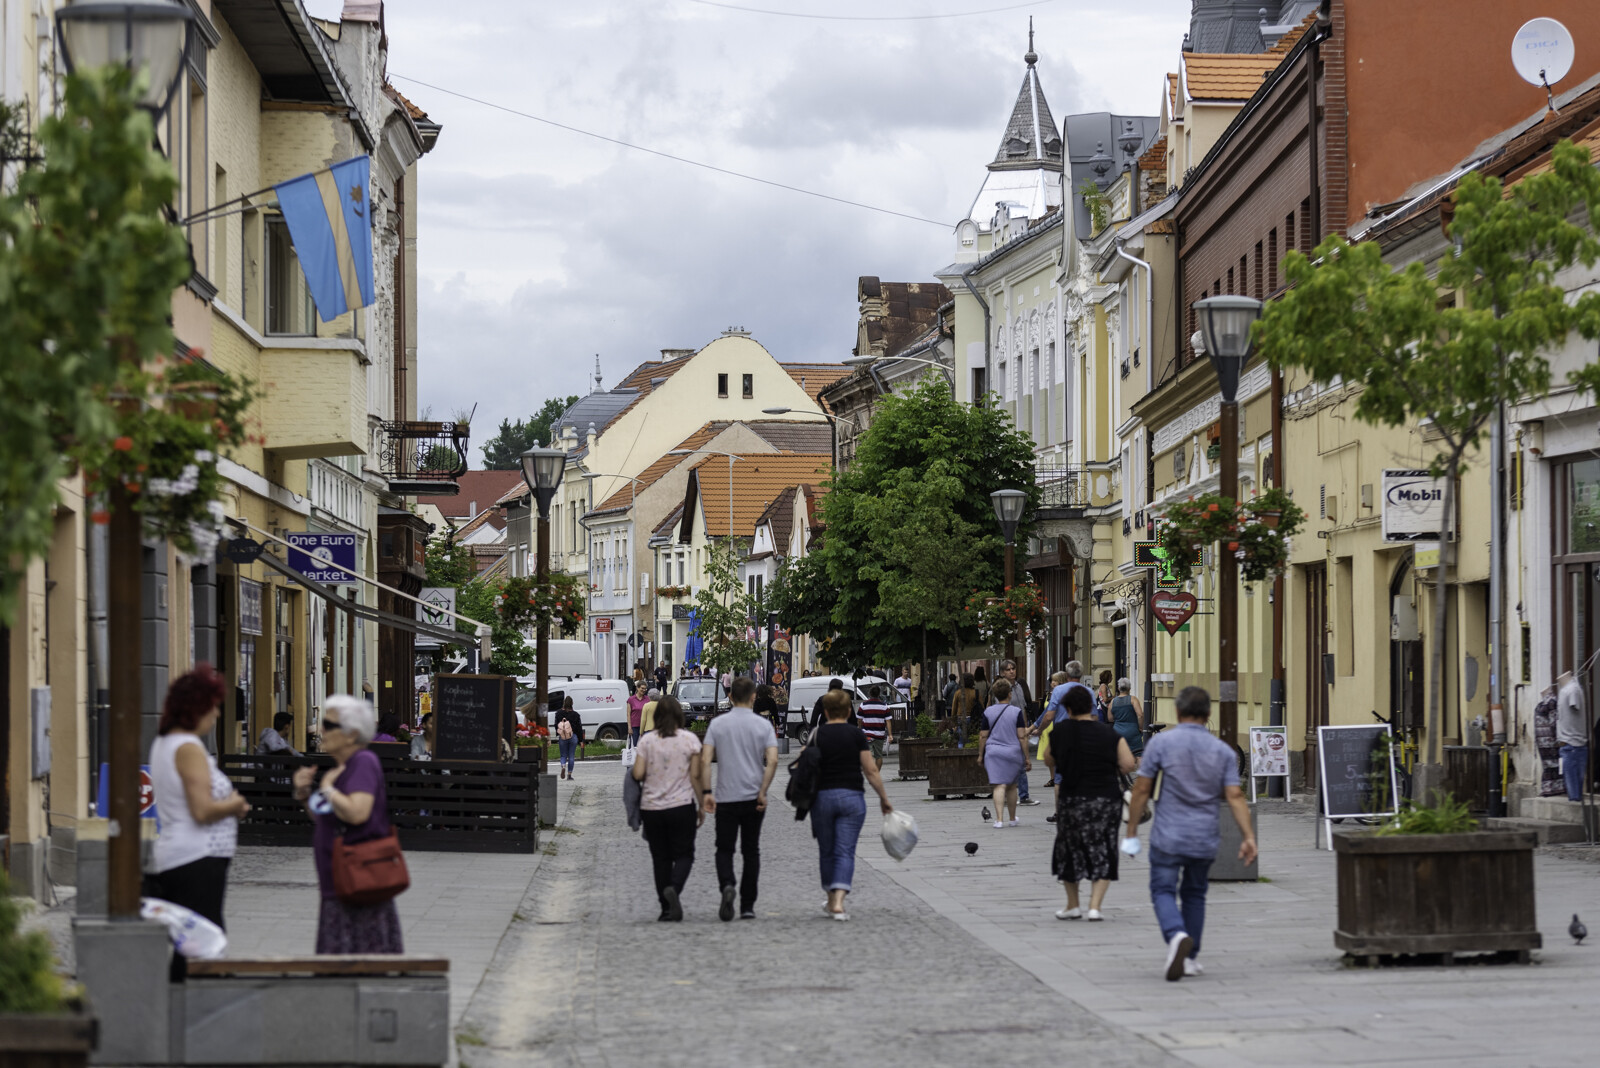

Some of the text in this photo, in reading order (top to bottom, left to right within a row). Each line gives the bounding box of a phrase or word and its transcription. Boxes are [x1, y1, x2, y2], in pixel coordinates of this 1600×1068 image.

[1398, 489, 1442, 501] Mobil
[289, 535, 354, 546] One Euro
